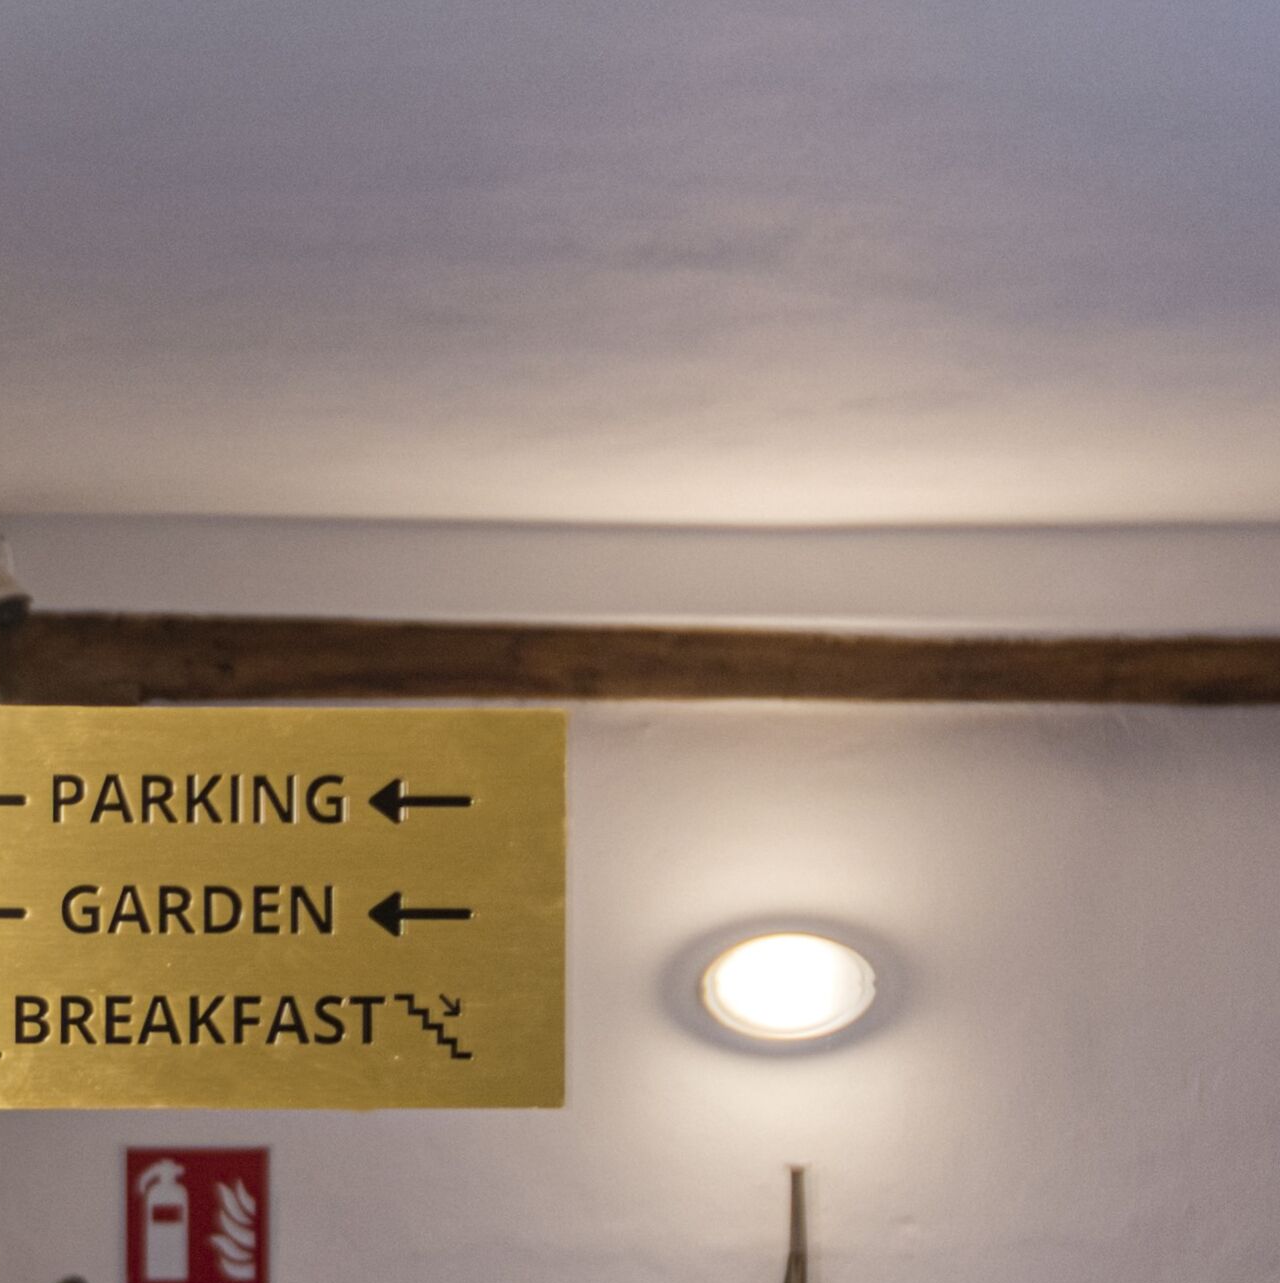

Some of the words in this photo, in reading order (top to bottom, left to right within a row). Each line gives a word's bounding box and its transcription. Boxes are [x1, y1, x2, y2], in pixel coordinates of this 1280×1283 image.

[51, 773, 348, 825] PARKING
[60, 884, 335, 935] GARDEN
[14, 994, 387, 1045] BREAKFAST
